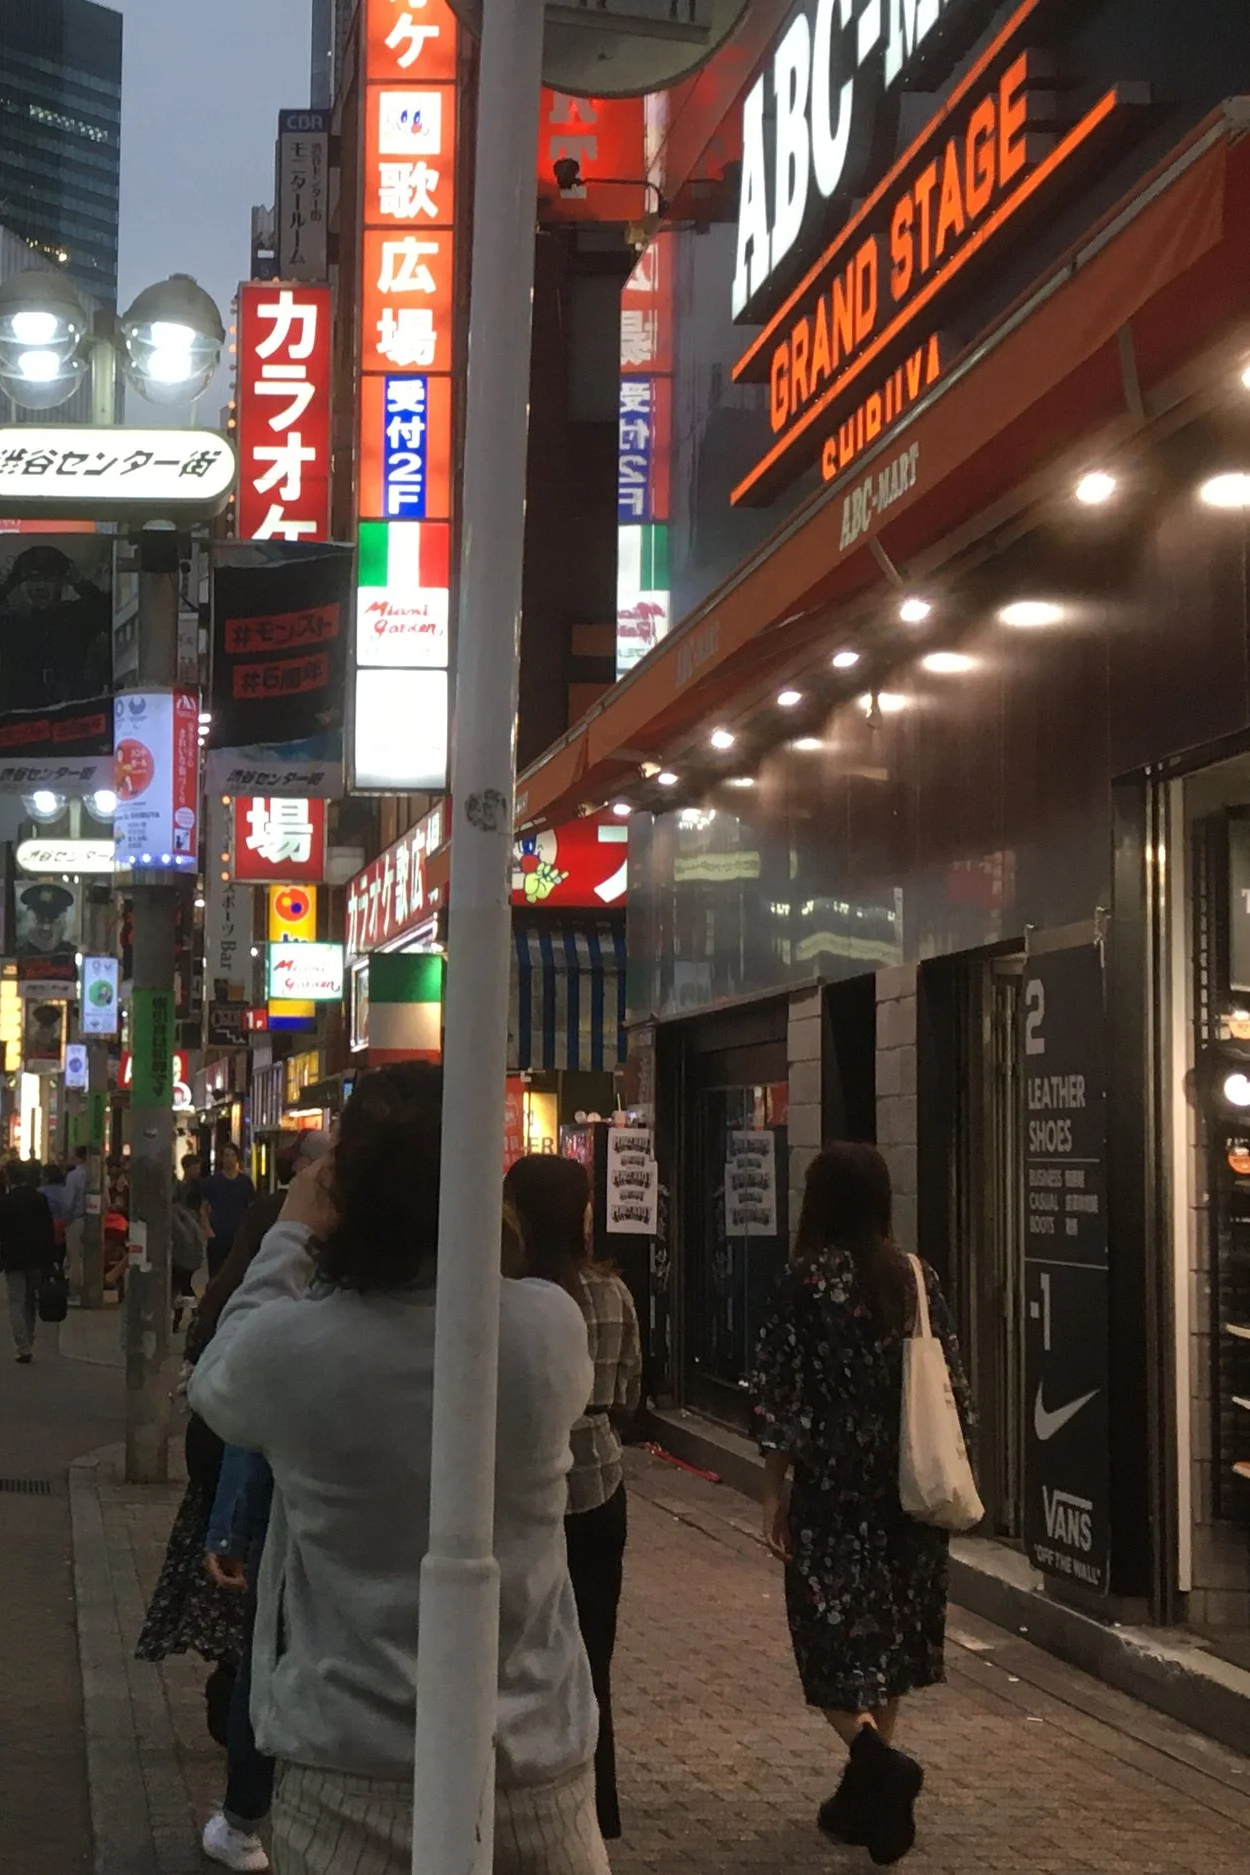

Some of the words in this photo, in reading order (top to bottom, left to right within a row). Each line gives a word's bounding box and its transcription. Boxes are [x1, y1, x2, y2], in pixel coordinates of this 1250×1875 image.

[289, 142, 308, 267] モニタールーム
[378, 161, 440, 367] 歌広場
[770, 234, 878, 433] GRAND
[891, 50, 1028, 301] STAGE
[387, 379, 427, 515] 受付2F
[839, 441, 919, 551] ABC-MART
[247, 797, 313, 863] 場
[1025, 978, 1046, 1056] 2
[1027, 1074, 1087, 1110] LEATHER
[1029, 1119, 1073, 1153] SHOES
[1029, 1168, 1063, 1188] BUSINESS
[1029, 1192, 1060, 1211] CASUAL
[1029, 1216, 1056, 1234] BOOTS
[1042, 1484, 1094, 1552] VANS
